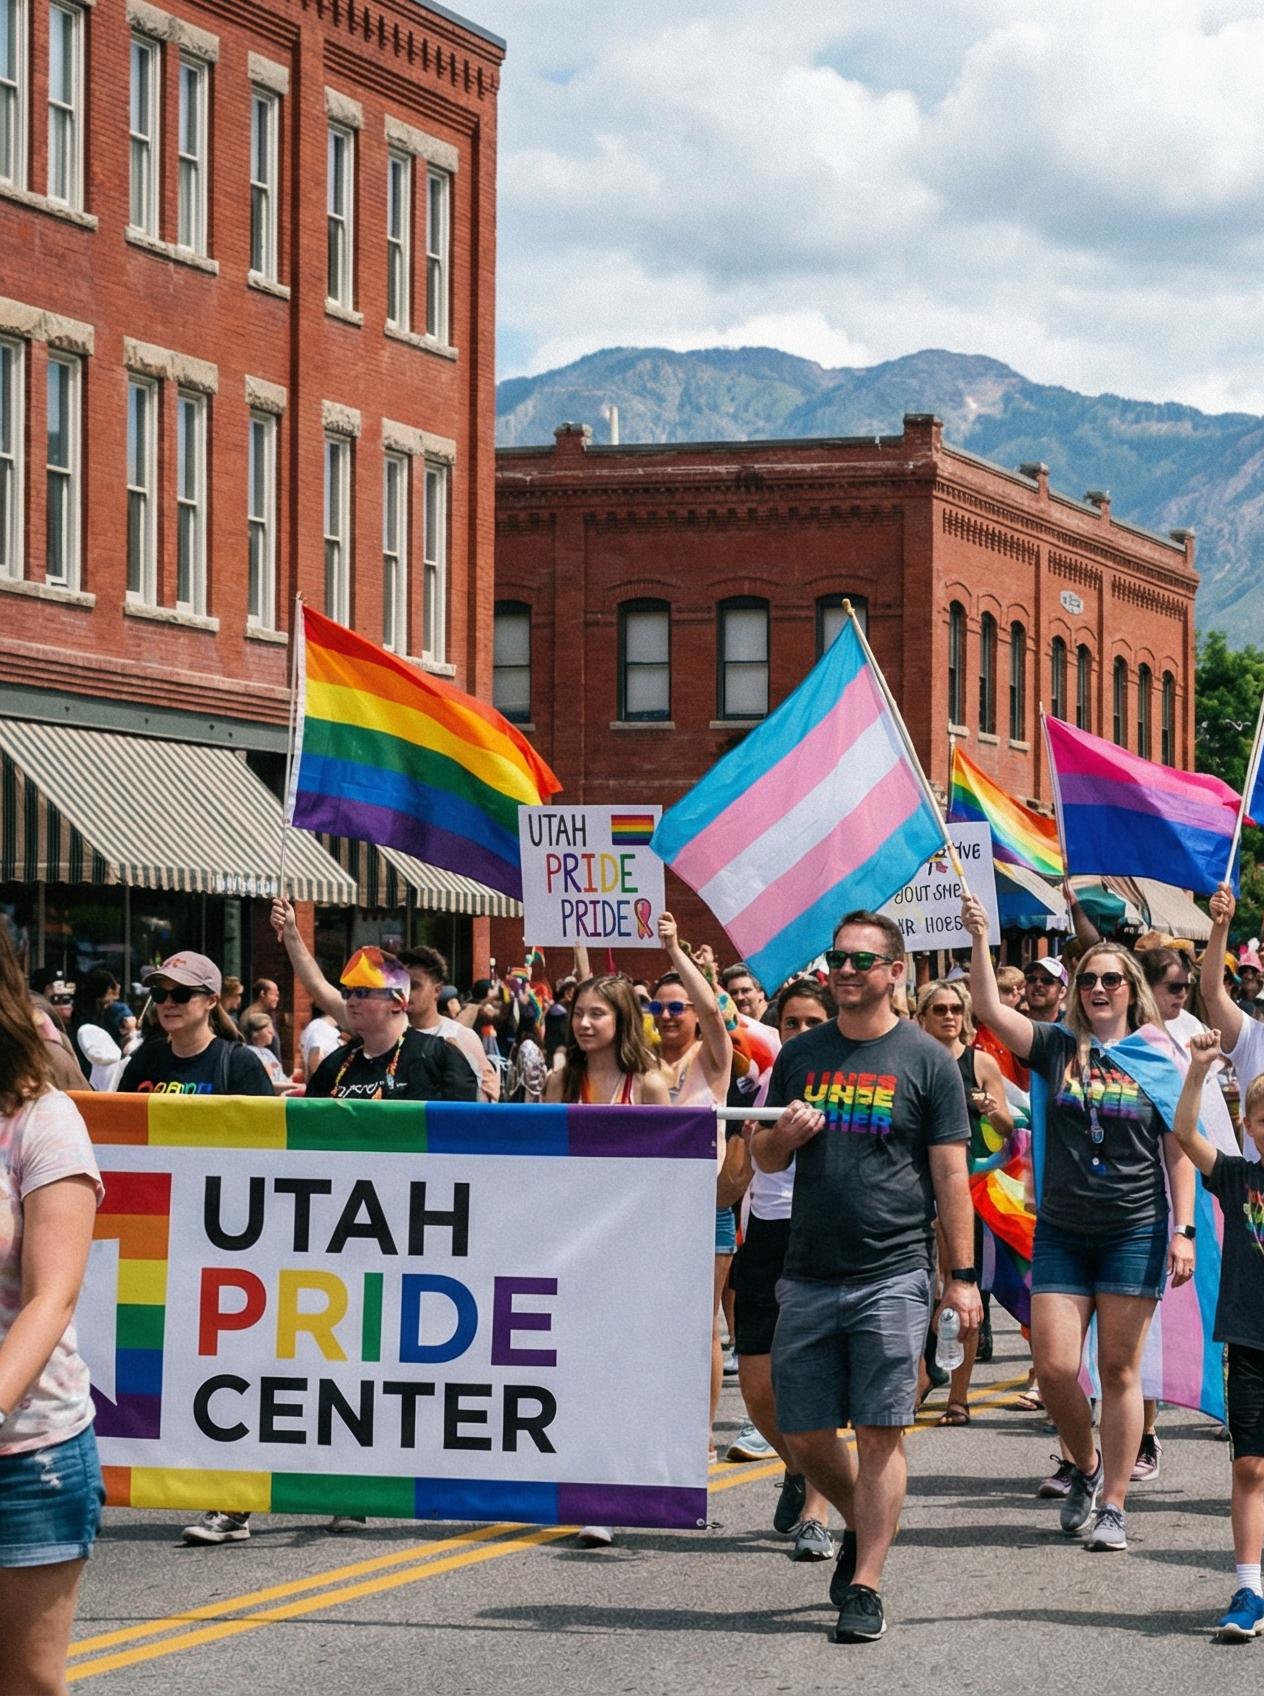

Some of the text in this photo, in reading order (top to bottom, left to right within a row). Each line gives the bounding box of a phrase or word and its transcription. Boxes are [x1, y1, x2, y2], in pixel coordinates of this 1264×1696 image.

[528, 814, 587, 847] UTAH
[546, 853, 639, 894] PRIDE
[561, 899, 632, 938] PRIDE
[203, 1175, 470, 1257] UTAH
[198, 1267, 558, 1368] PRIDE
[193, 1374, 558, 1454] CENTER
